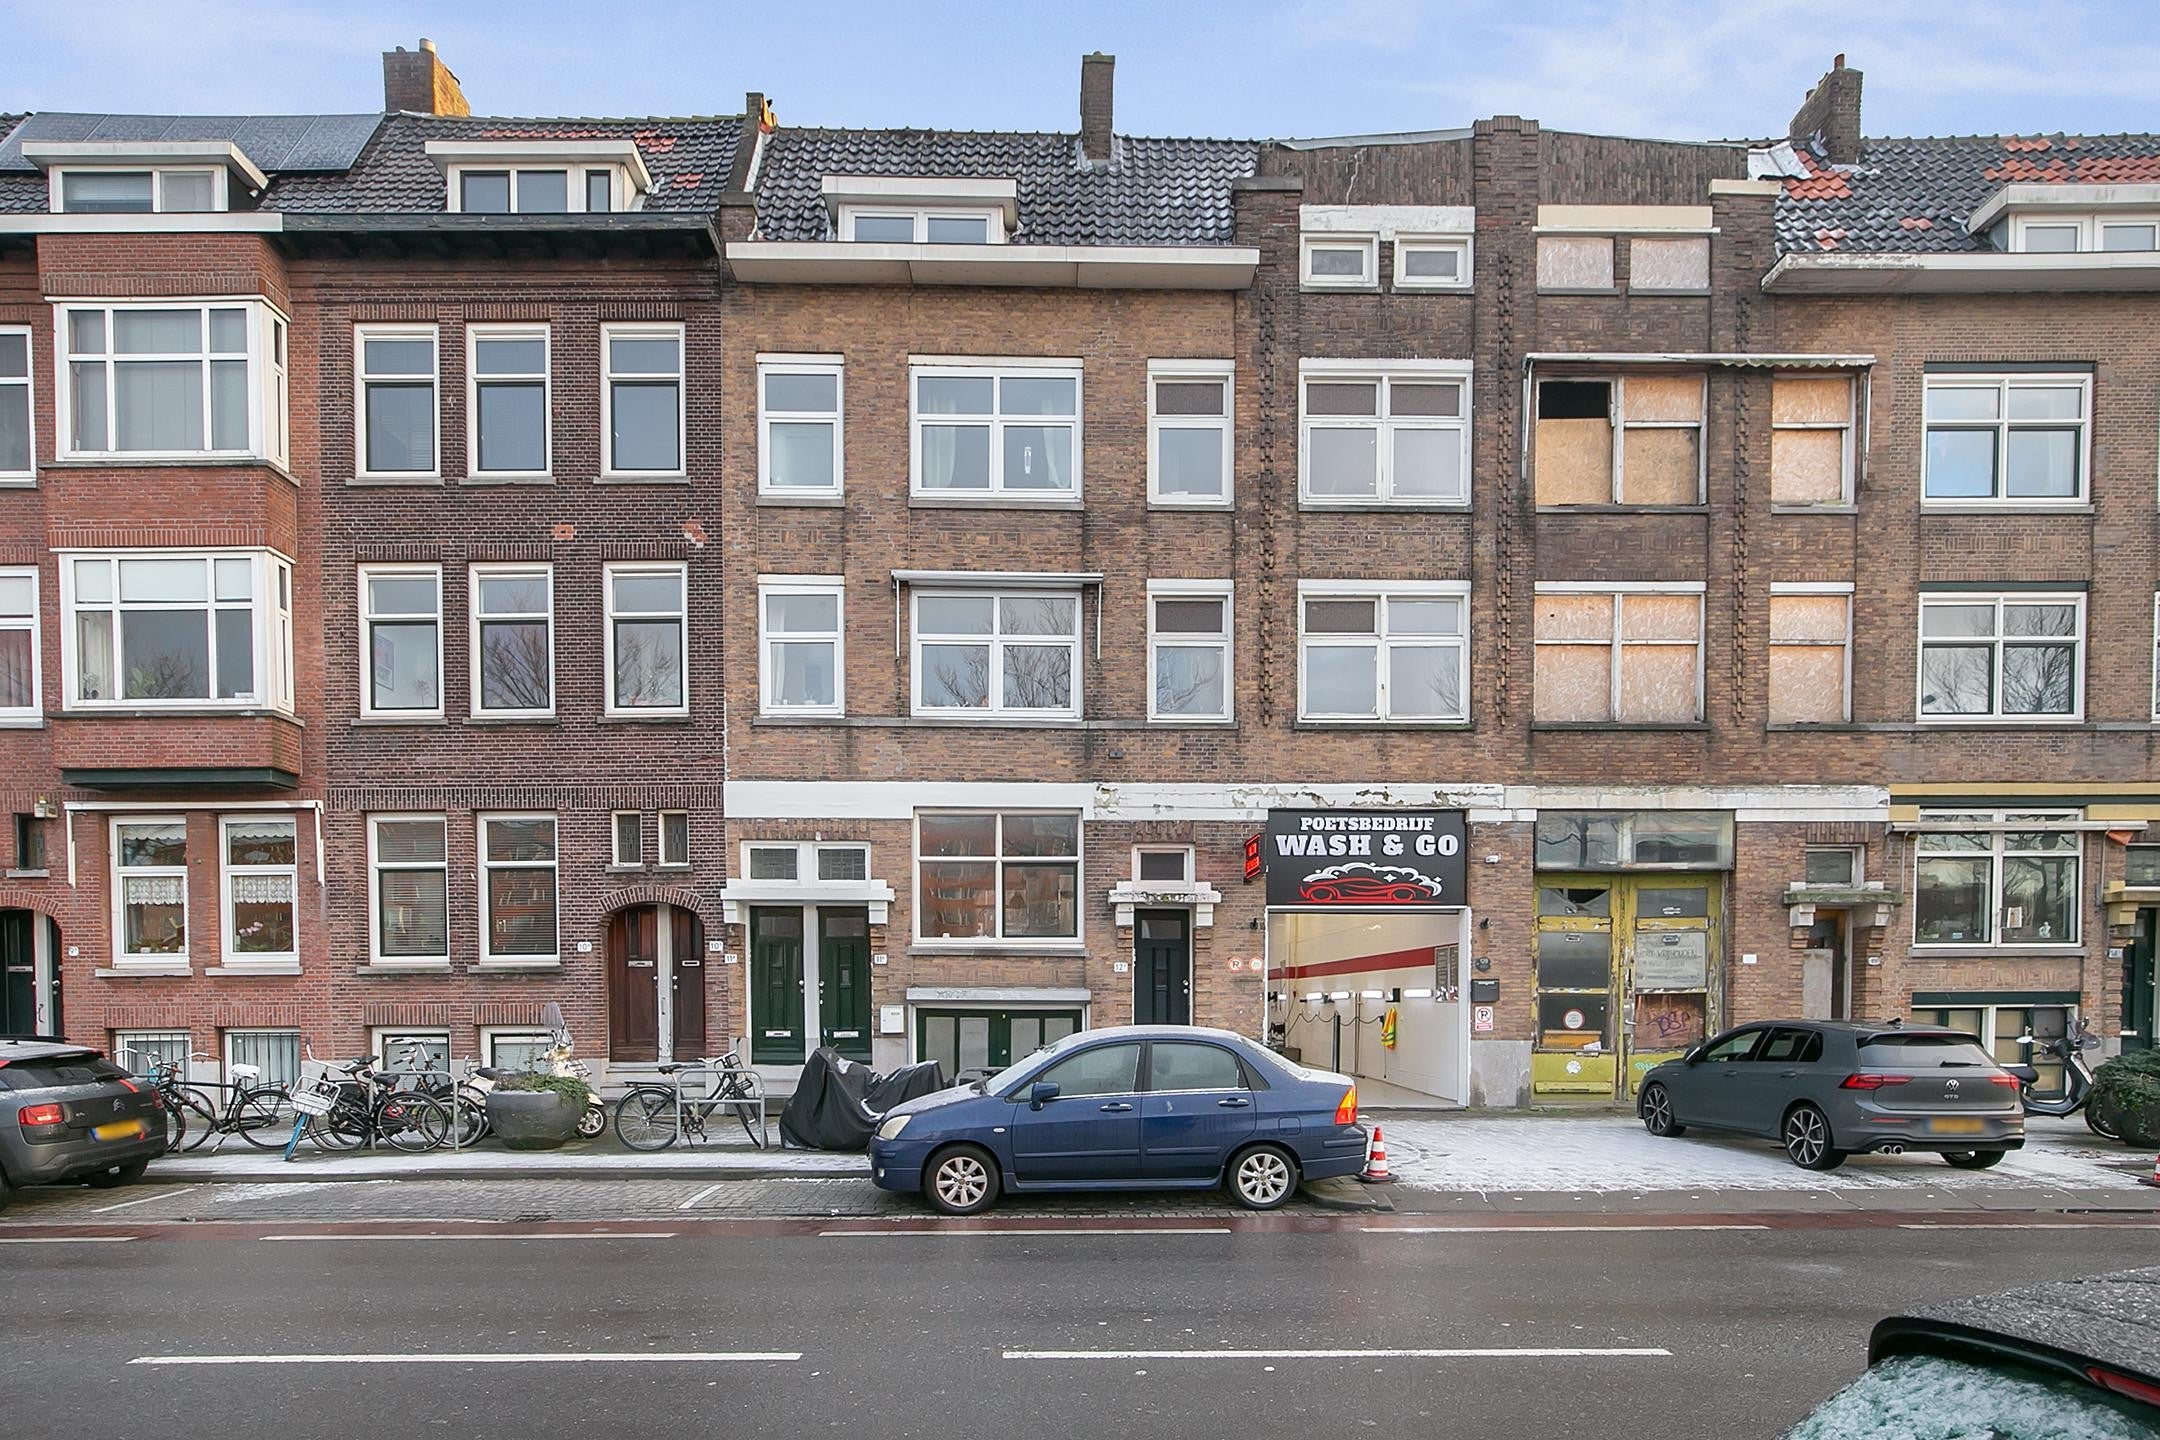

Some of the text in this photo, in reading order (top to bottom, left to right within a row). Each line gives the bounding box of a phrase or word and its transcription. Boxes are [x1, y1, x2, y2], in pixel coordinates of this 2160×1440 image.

[1299, 817, 1435, 832] POETSBEDRIJF
[1275, 834, 1371, 857] WASH
[1382, 834, 1405, 857] &
[1415, 834, 1459, 857] GO
